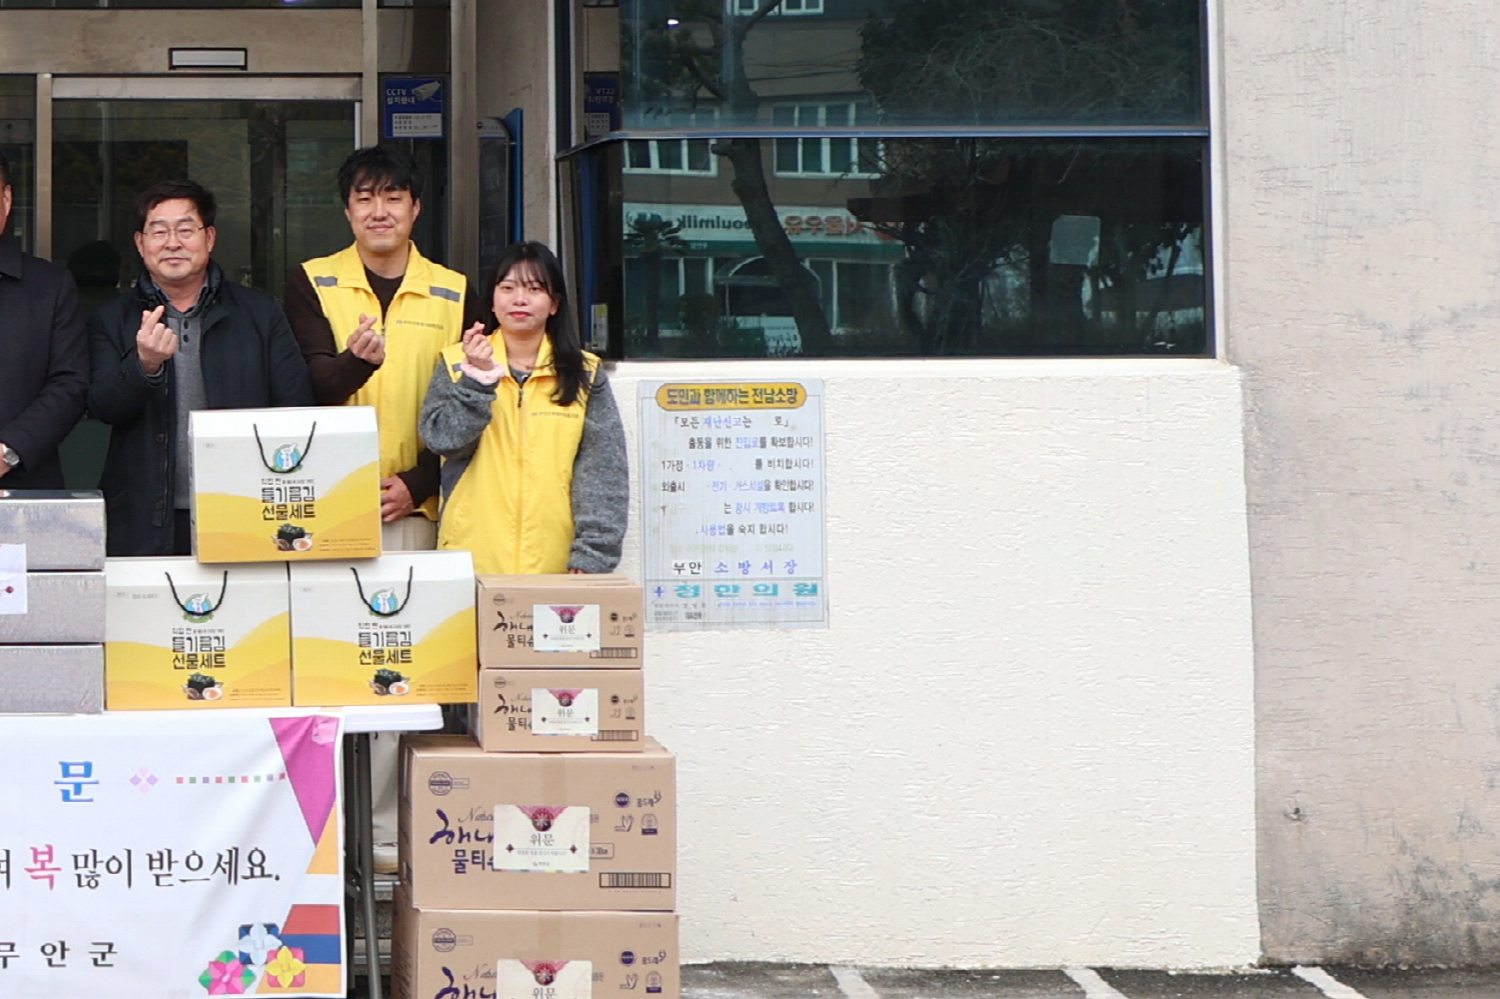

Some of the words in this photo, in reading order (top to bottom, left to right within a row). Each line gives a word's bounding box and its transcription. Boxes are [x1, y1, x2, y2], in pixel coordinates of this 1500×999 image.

[386, 88, 407, 96] CCTV
[666, 388, 701, 405] 도민과
[704, 388, 750, 405] 함께하는
[752, 387, 799, 404] 전남소방
[703, 416, 752, 429] 재난신고는
[715, 436, 732, 449] 위한
[262, 486, 315, 504] 들기름김
[262, 505, 316, 521] 선물세트
[738, 523, 756, 535] 숙지
[172, 635, 226, 653] 들기름김
[358, 631, 412, 648] 들기름김
[172, 653, 226, 670] 선물세트
[359, 649, 413, 665] 선물세트
[530, 833, 555, 847] 위문
[24, 845, 62, 890] 복
[71, 849, 132, 890] 많이
[146, 846, 281, 888] 받으세요.
[531, 986, 557, 999] 위문
